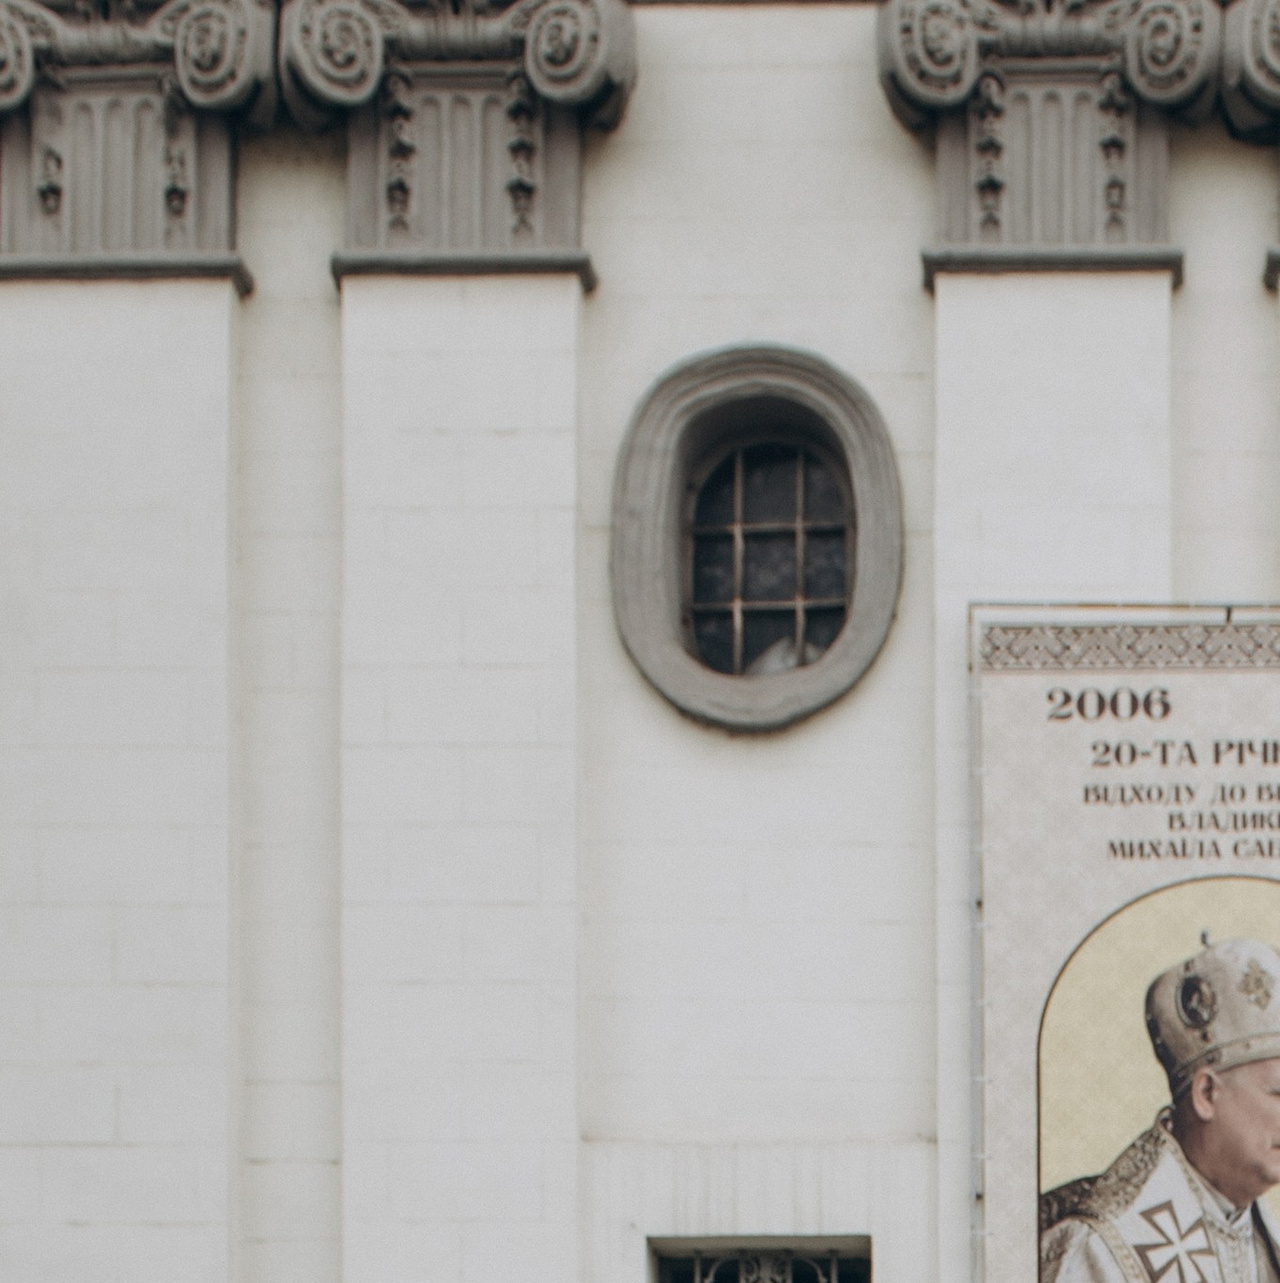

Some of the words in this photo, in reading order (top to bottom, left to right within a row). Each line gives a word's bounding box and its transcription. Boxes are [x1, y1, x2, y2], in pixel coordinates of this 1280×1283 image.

[1046, 686, 1173, 721] 2006
[1091, 739, 1198, 768] 20-ТА
[1083, 782, 1197, 806] ВІДХОДУ
[1210, 782, 1247, 806] ДО
